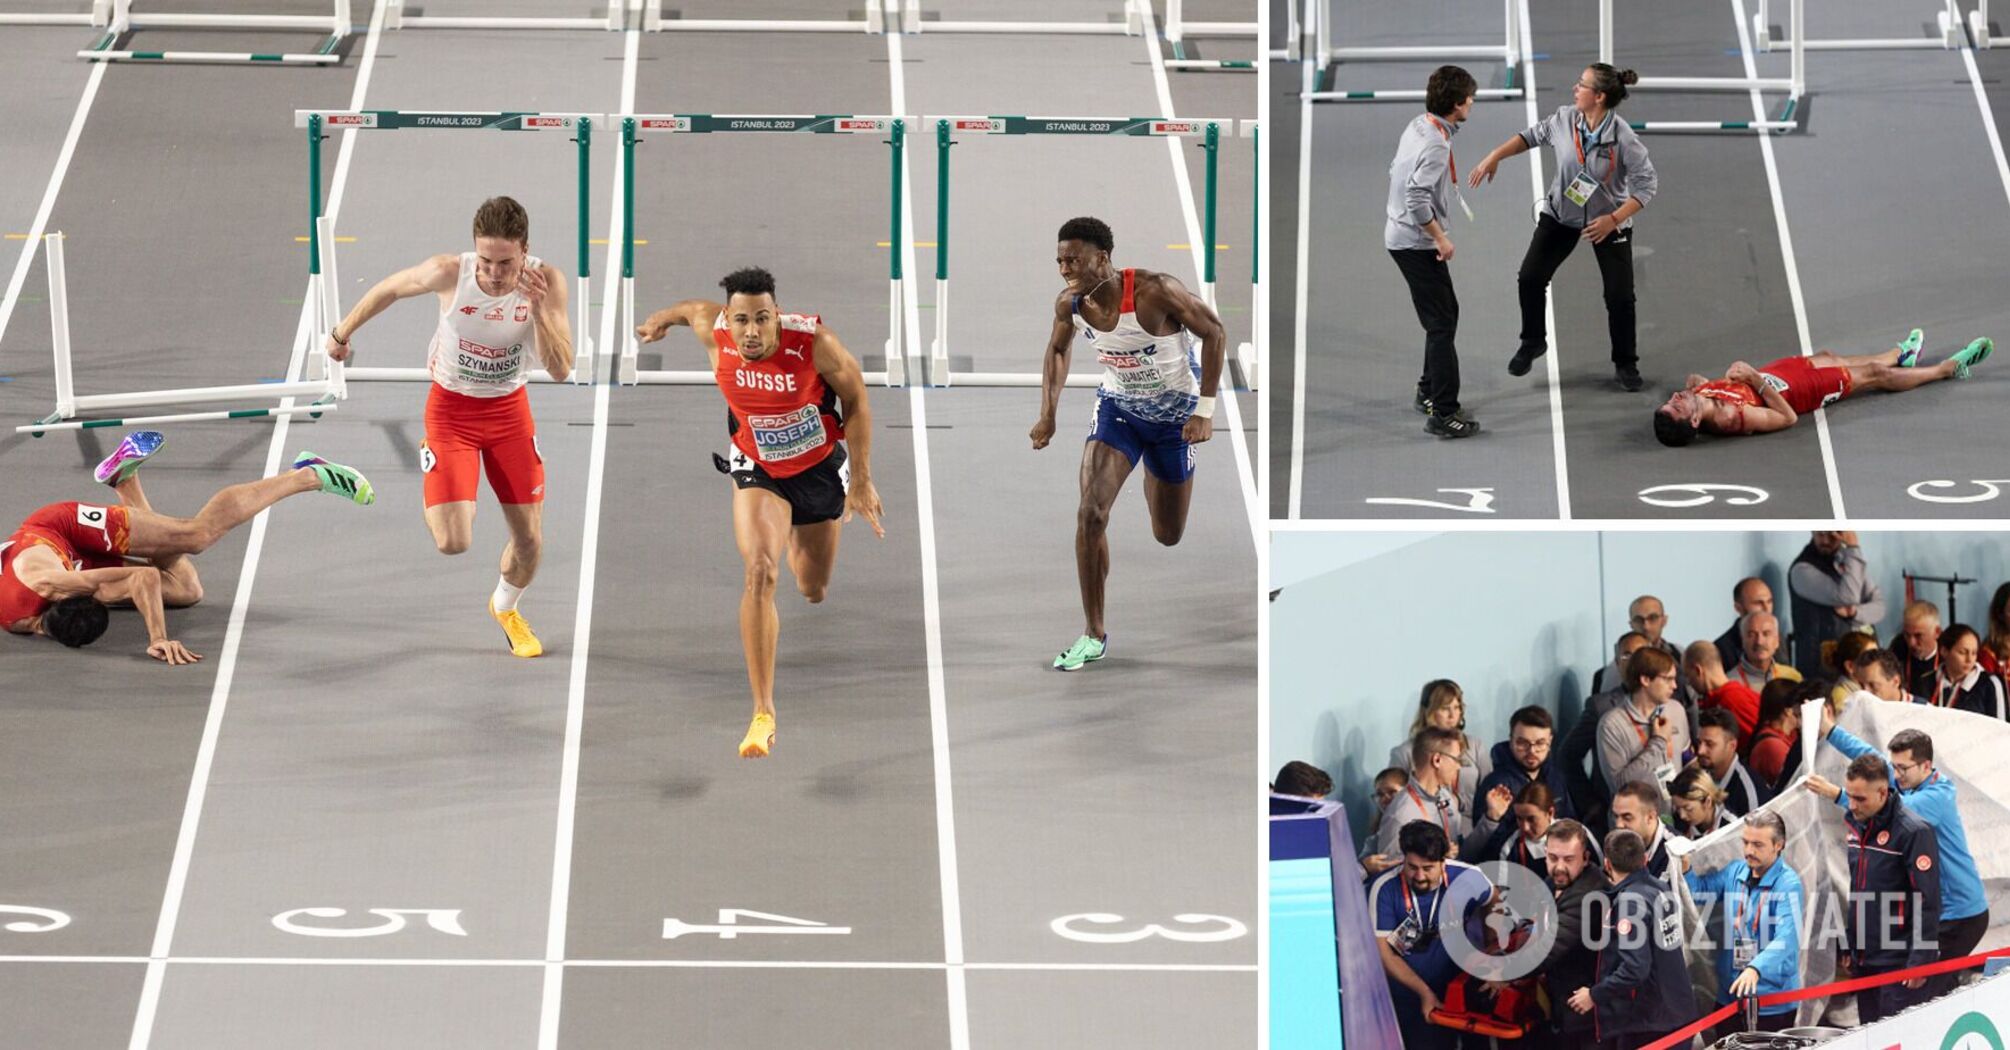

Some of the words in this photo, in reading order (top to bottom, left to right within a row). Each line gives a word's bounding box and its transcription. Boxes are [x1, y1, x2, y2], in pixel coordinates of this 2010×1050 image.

[336, 116, 363, 124] SPAR
[417, 117, 459, 125] ISTANBUL
[535, 118, 562, 126] SPAR
[650, 120, 676, 128] SPAR
[730, 120, 772, 128] ISTANBUL
[849, 121, 875, 129] SPAR
[964, 121, 991, 129] SPAR
[1045, 122, 1087, 131] ISTANBUL
[1089, 123, 1110, 131] 2023
[1163, 123, 1190, 132] SPAR
[460, 341, 505, 358] SPAR
[458, 354, 520, 372] SZYMANSKI
[752, 413, 800, 428] SPAR
[757, 416, 819, 445] JOSEPH
[734, 453, 746, 467] 4
[1364, 487, 1497, 514] 7
[1637, 483, 1770, 508] 6
[270, 906, 469, 938] 5
[662, 908, 852, 939] 4
[1048, 912, 1250, 944] 3
